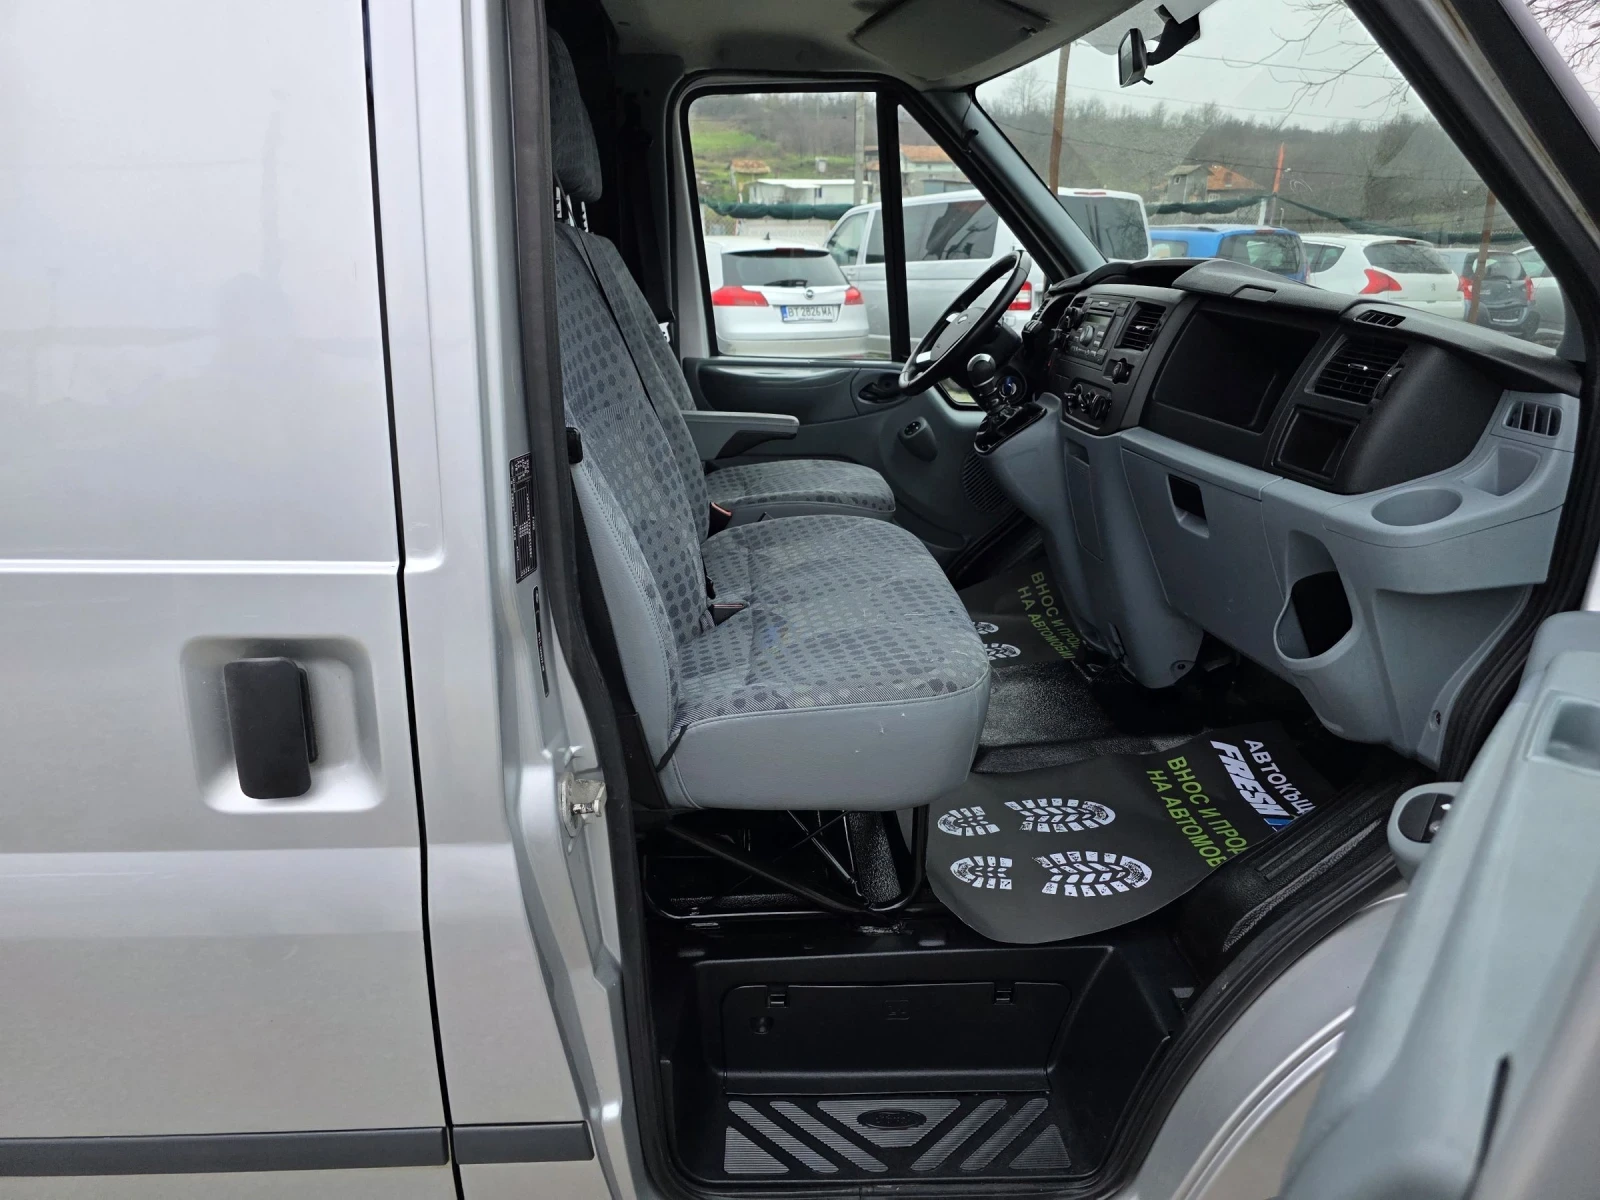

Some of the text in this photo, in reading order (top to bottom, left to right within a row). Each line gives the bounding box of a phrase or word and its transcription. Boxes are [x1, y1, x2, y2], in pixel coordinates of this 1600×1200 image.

[1017, 585, 1036, 611] НА
[1031, 571, 1059, 617] ВНОС
[1051, 618, 1066, 627] И
[1146, 770, 1173, 793] НА
[1166, 755, 1210, 805] ВНОС
[1197, 807, 1222, 819] И
[1209, 740, 1291, 817] FRESH
[1243, 739, 1317, 816] АВТОКЪЩ
